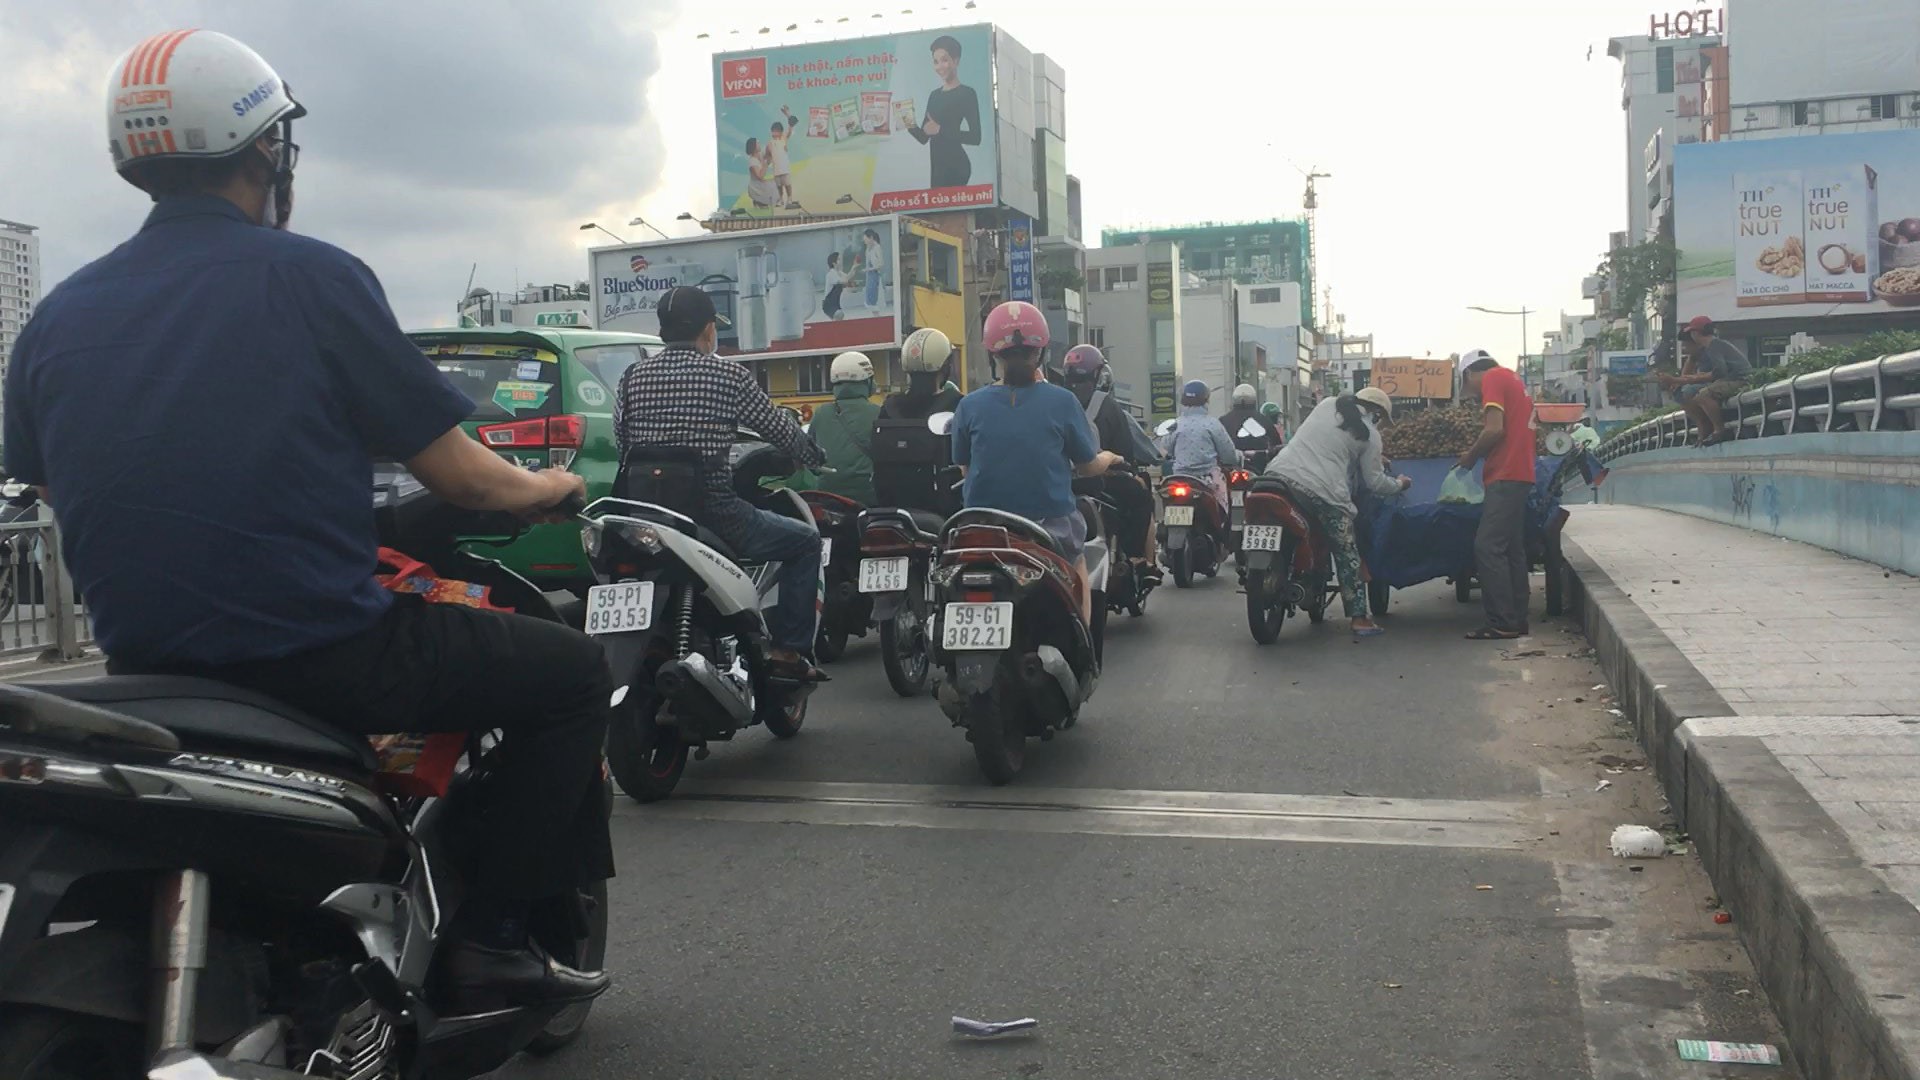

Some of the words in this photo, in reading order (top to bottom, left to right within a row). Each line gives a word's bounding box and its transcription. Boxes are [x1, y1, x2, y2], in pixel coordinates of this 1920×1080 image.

[777, 64, 801, 78] thịt
[803, 58, 833, 75] thật,
[867, 51, 898, 66] thật,
[726, 77, 762, 92] VIFON
[787, 78, 804, 91] bé
[844, 73, 863, 87] mẹ
[867, 69, 888, 82] vui
[880, 196, 906, 209] Cháo
[908, 195, 920, 206] số
[922, 191, 929, 205] 1
[931, 194, 950, 205] của
[951, 192, 974, 203] siêu
[975, 188, 993, 201] nhí
[1740, 190, 1763, 202] TH
[1809, 187, 1830, 199] TH
[1739, 203, 1782, 220] true
[1808, 199, 1848, 216] true
[1740, 219, 1783, 236] NUT
[1809, 215, 1849, 231] NUT
[603, 274, 677, 295] BlueStone
[544, 313, 572, 325] TAXI
[1377, 375, 1398, 395] 13
[1247, 526, 1279, 538] 62-S2
[866, 575, 901, 590] 4456
[597, 586, 641, 608] 59-P1
[590, 607, 647, 631] 893.53
[956, 606, 1000, 625] 59-G1
[948, 626, 1006, 647] 382.21
